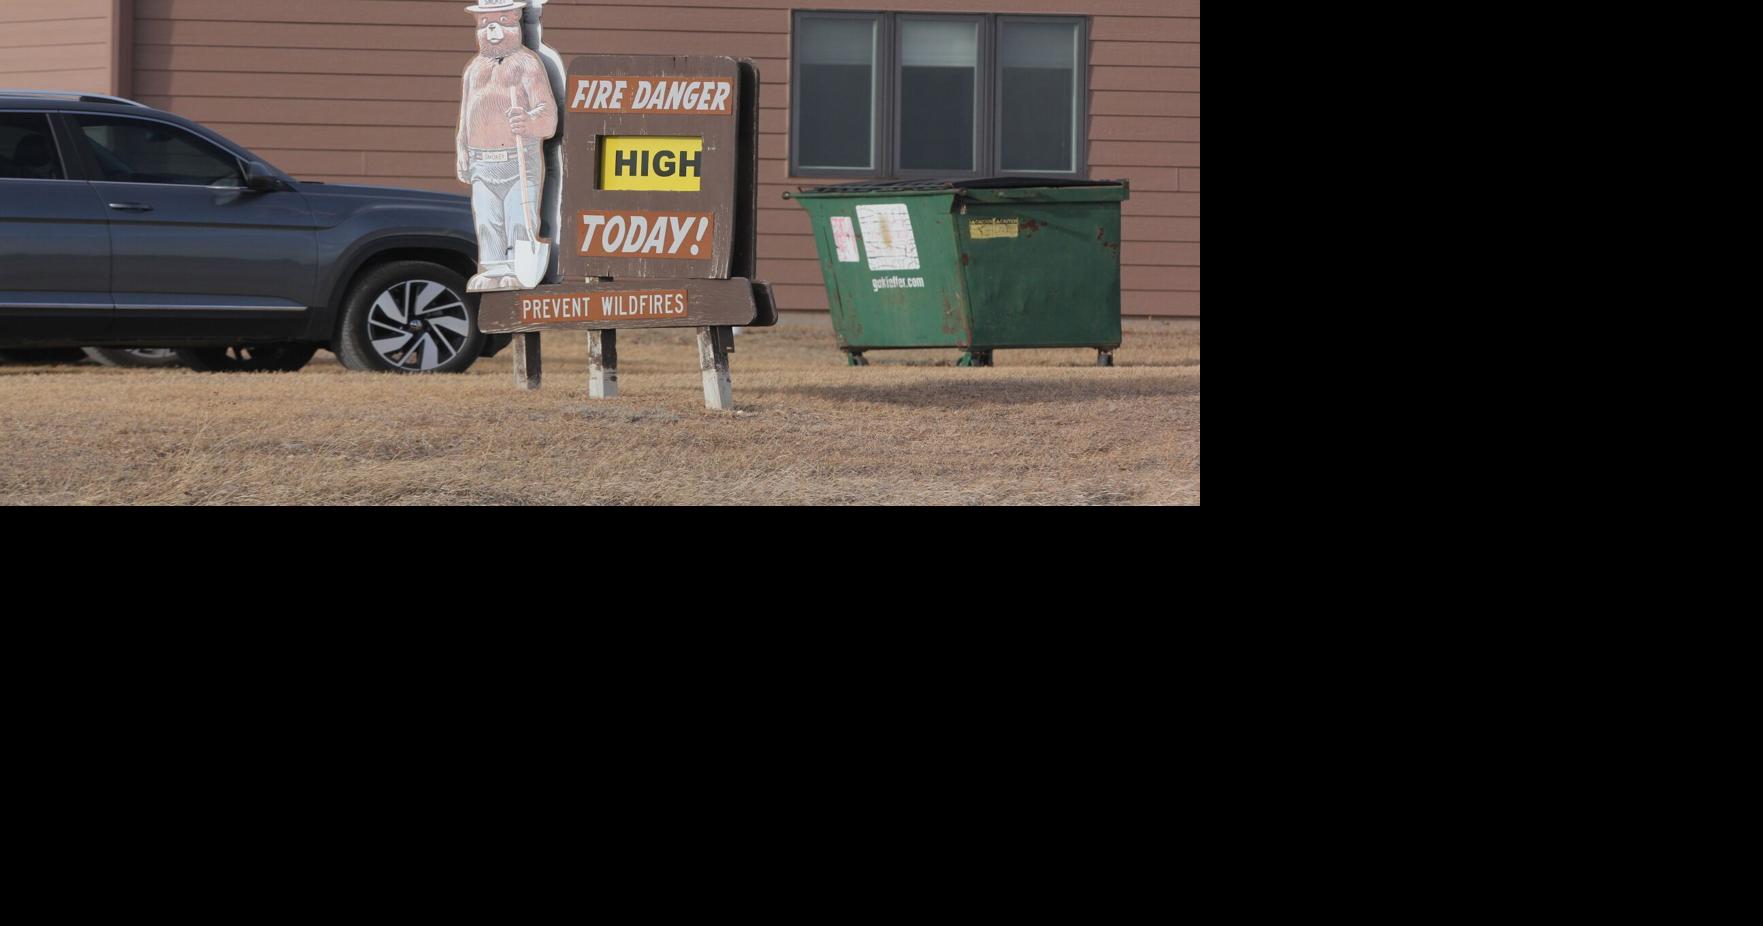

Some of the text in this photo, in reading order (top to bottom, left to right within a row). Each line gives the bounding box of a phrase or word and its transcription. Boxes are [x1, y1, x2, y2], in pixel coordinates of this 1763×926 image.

[571, 79, 731, 111] FIRE DANGER
[615, 149, 702, 178] HIGH
[580, 214, 709, 256] TODAY!
[872, 275, 925, 292] gokieffer.com
[522, 293, 685, 320] PREVENT WILDFIRES
